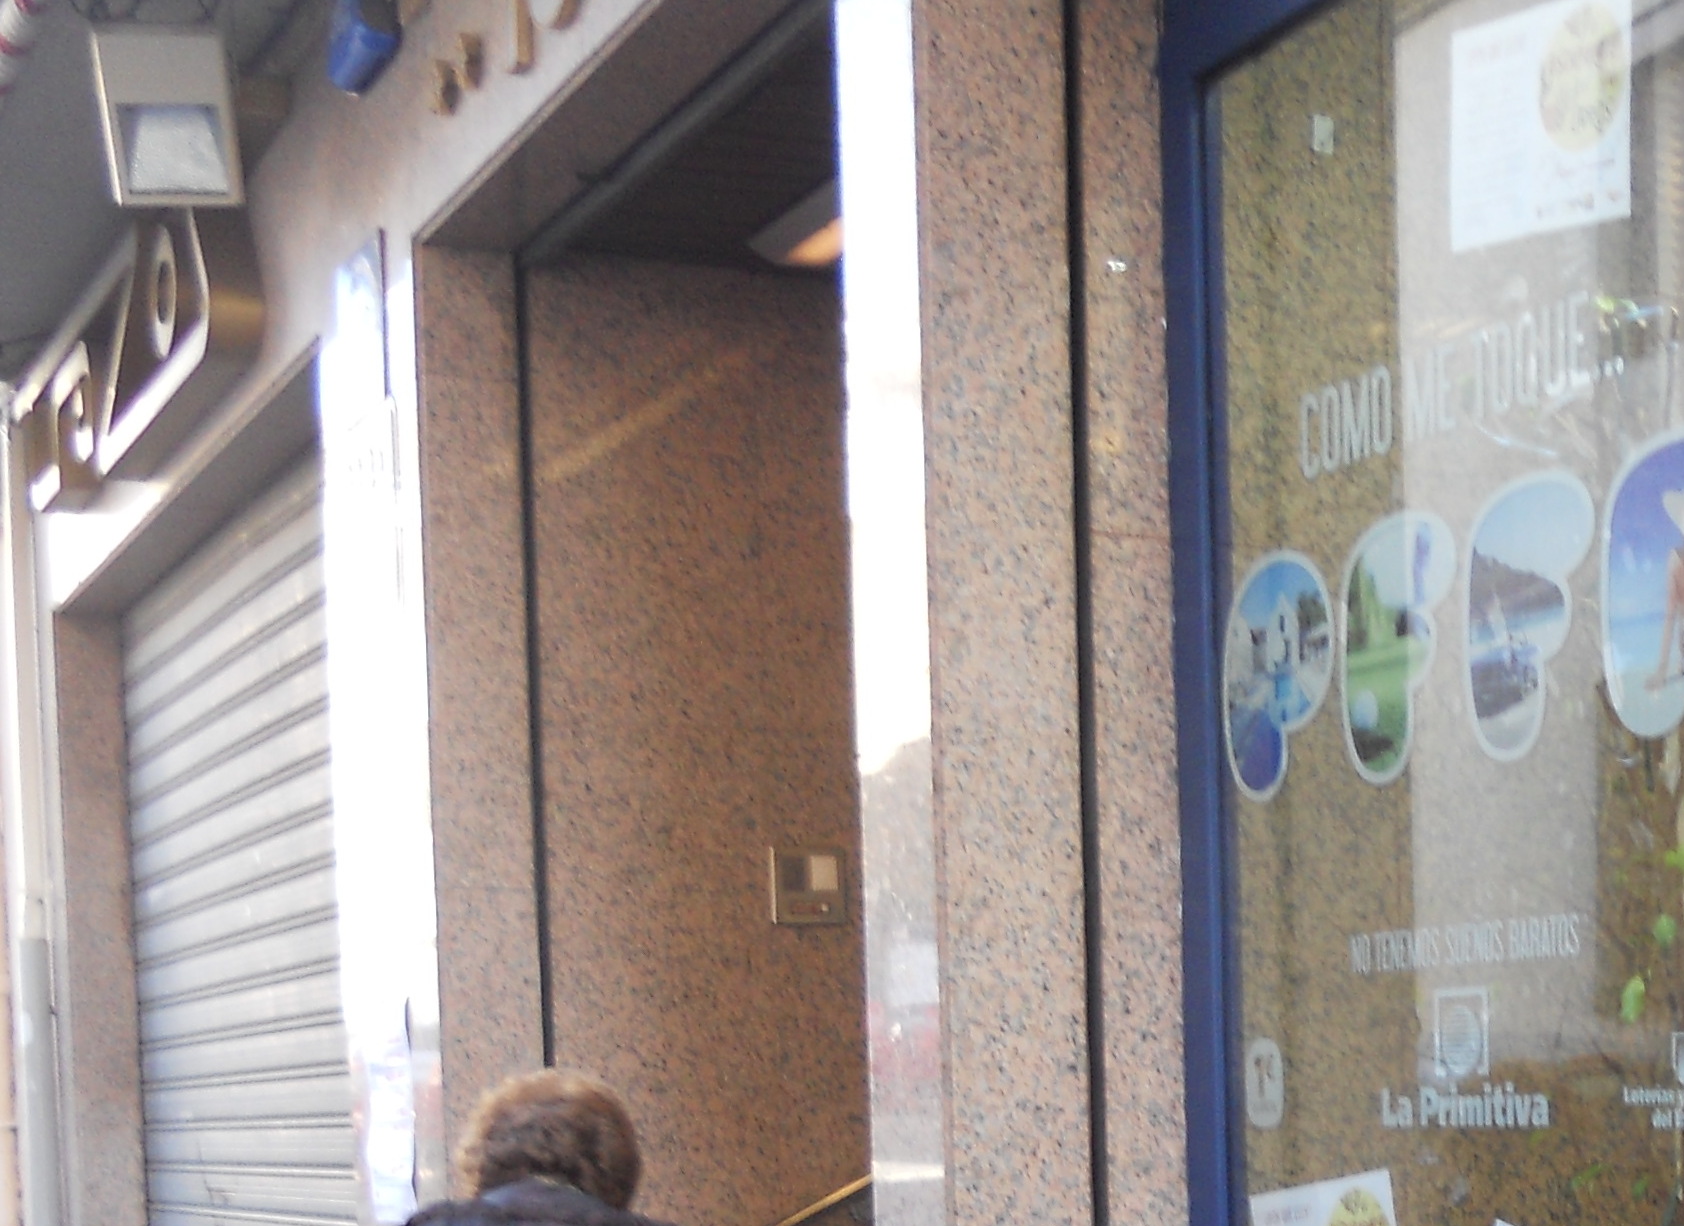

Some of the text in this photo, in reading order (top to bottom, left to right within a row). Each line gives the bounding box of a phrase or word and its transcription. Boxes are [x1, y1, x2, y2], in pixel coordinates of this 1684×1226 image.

[1301, 365, 1392, 480] COMO
[1381, 1081, 1550, 1127] La Primitiva
